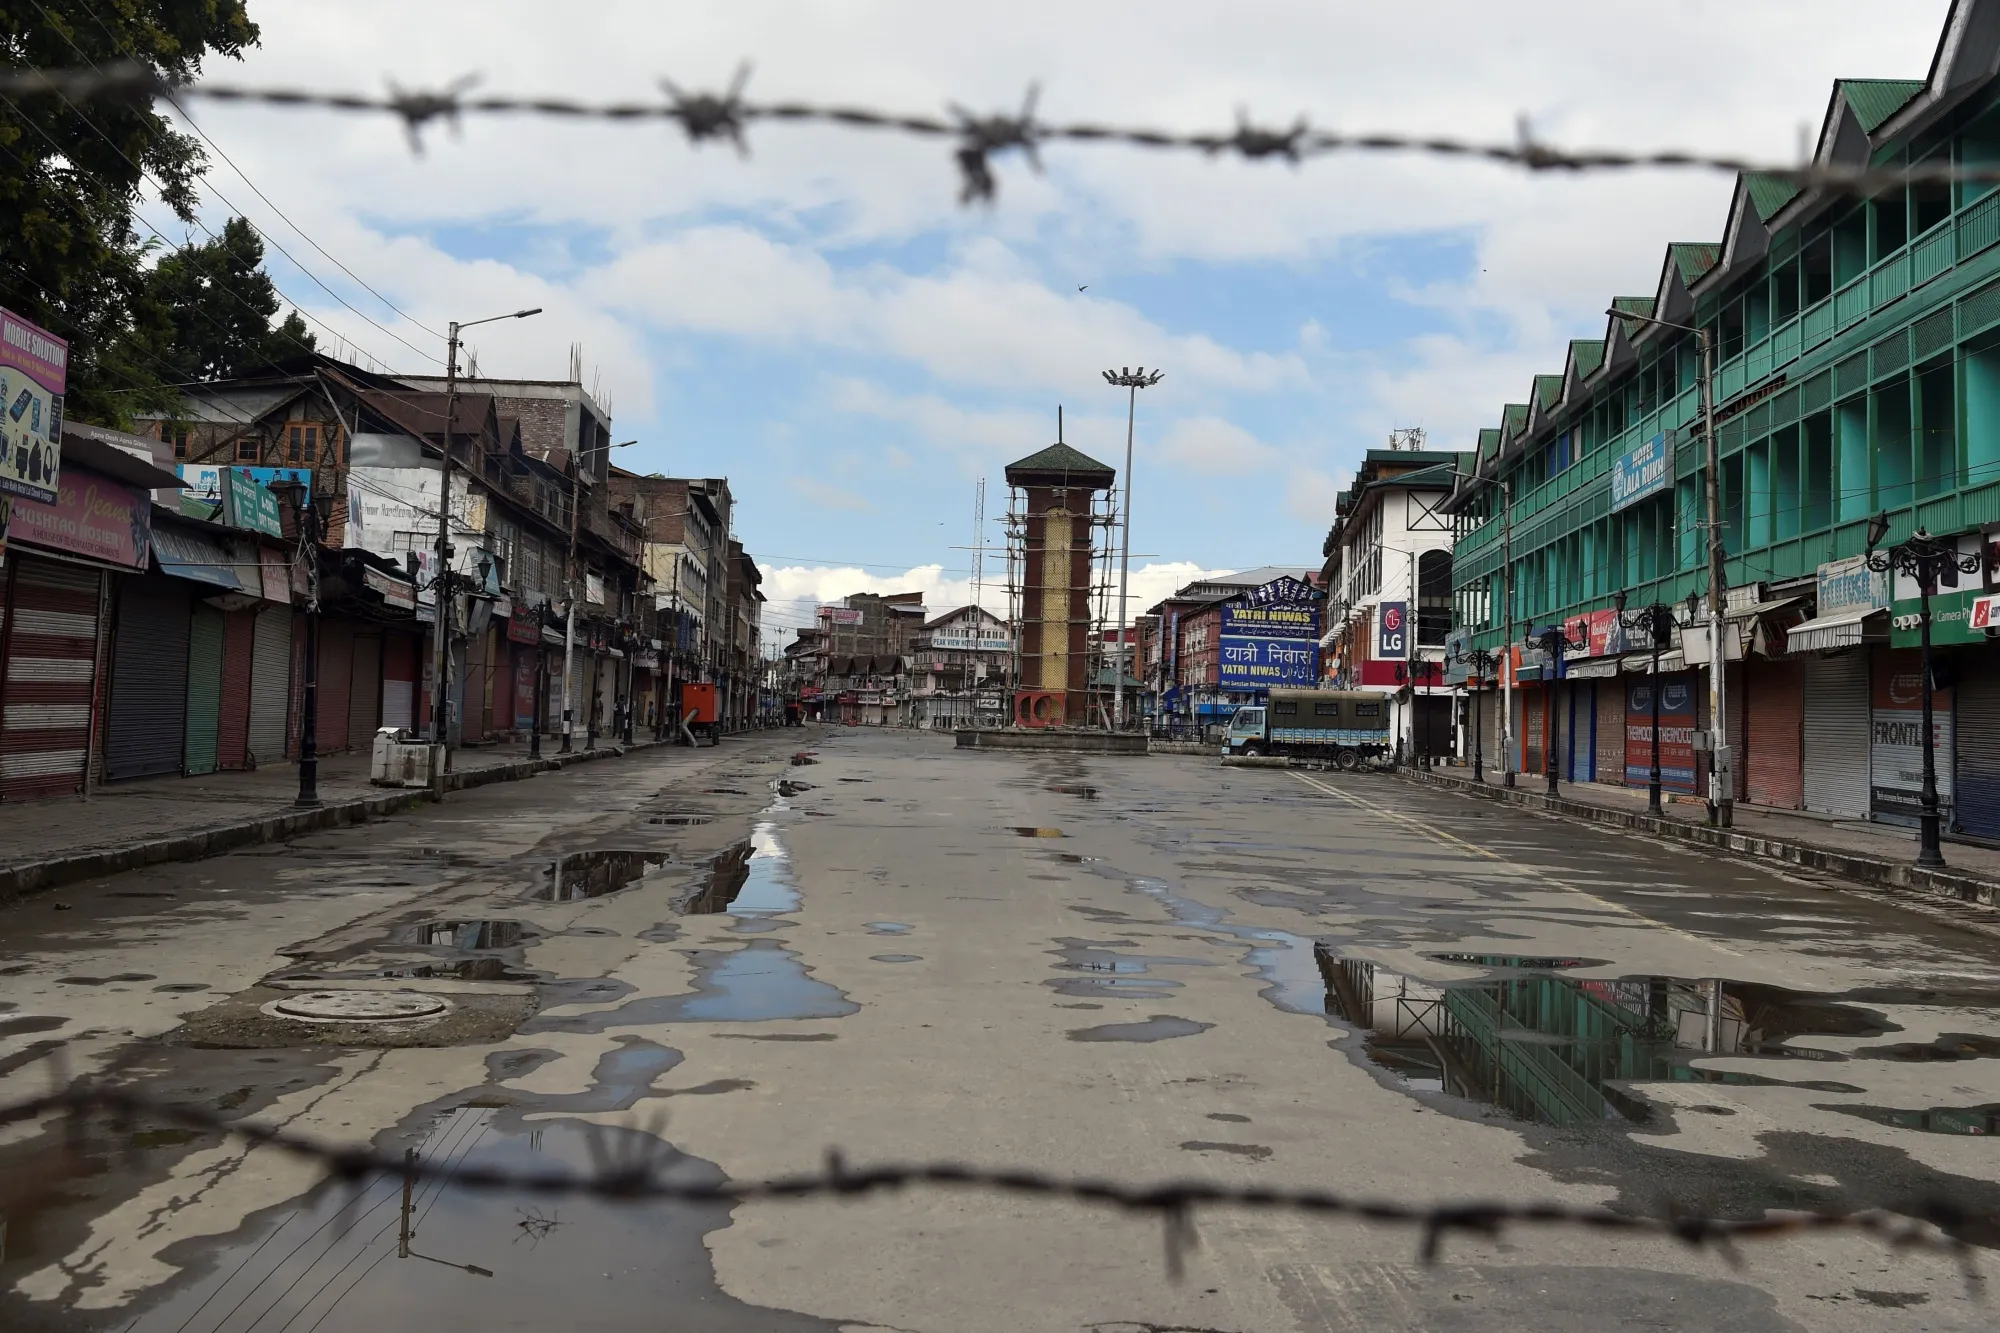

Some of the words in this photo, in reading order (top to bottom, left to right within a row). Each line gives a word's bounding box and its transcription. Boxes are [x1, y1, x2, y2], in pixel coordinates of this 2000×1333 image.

[3, 320, 31, 352] MOBILE
[32, 334, 65, 368] SOLUTION
[90, 430, 105, 440] Apna
[106, 434, 119, 443] Desh
[119, 437, 133, 446] Apna
[1632, 441, 1654, 468] HOTEL
[1623, 470, 1640, 496] LALA
[1641, 457, 1664, 486] RUKH
[84, 483, 131, 523] Jeans
[36, 529, 55, 542] HOUSE
[56, 532, 64, 543] OF
[79, 523, 126, 549] HOSIERY
[1232, 609, 1266, 620] YATRI
[1269, 610, 1311, 623] NIWAS
[1892, 613, 1932, 631] opp
[1937, 610, 1961, 622] Camera
[933, 638, 946, 646] PEAK
[1383, 633, 1402, 650] LG
[1224, 642, 1258, 662] यात्री
[1267, 643, 1314, 664] निवास
[1221, 664, 1247, 675] YATRI
[1250, 665, 1281, 676] NIWAS
[1873, 721, 1941, 748] FRONTLE
